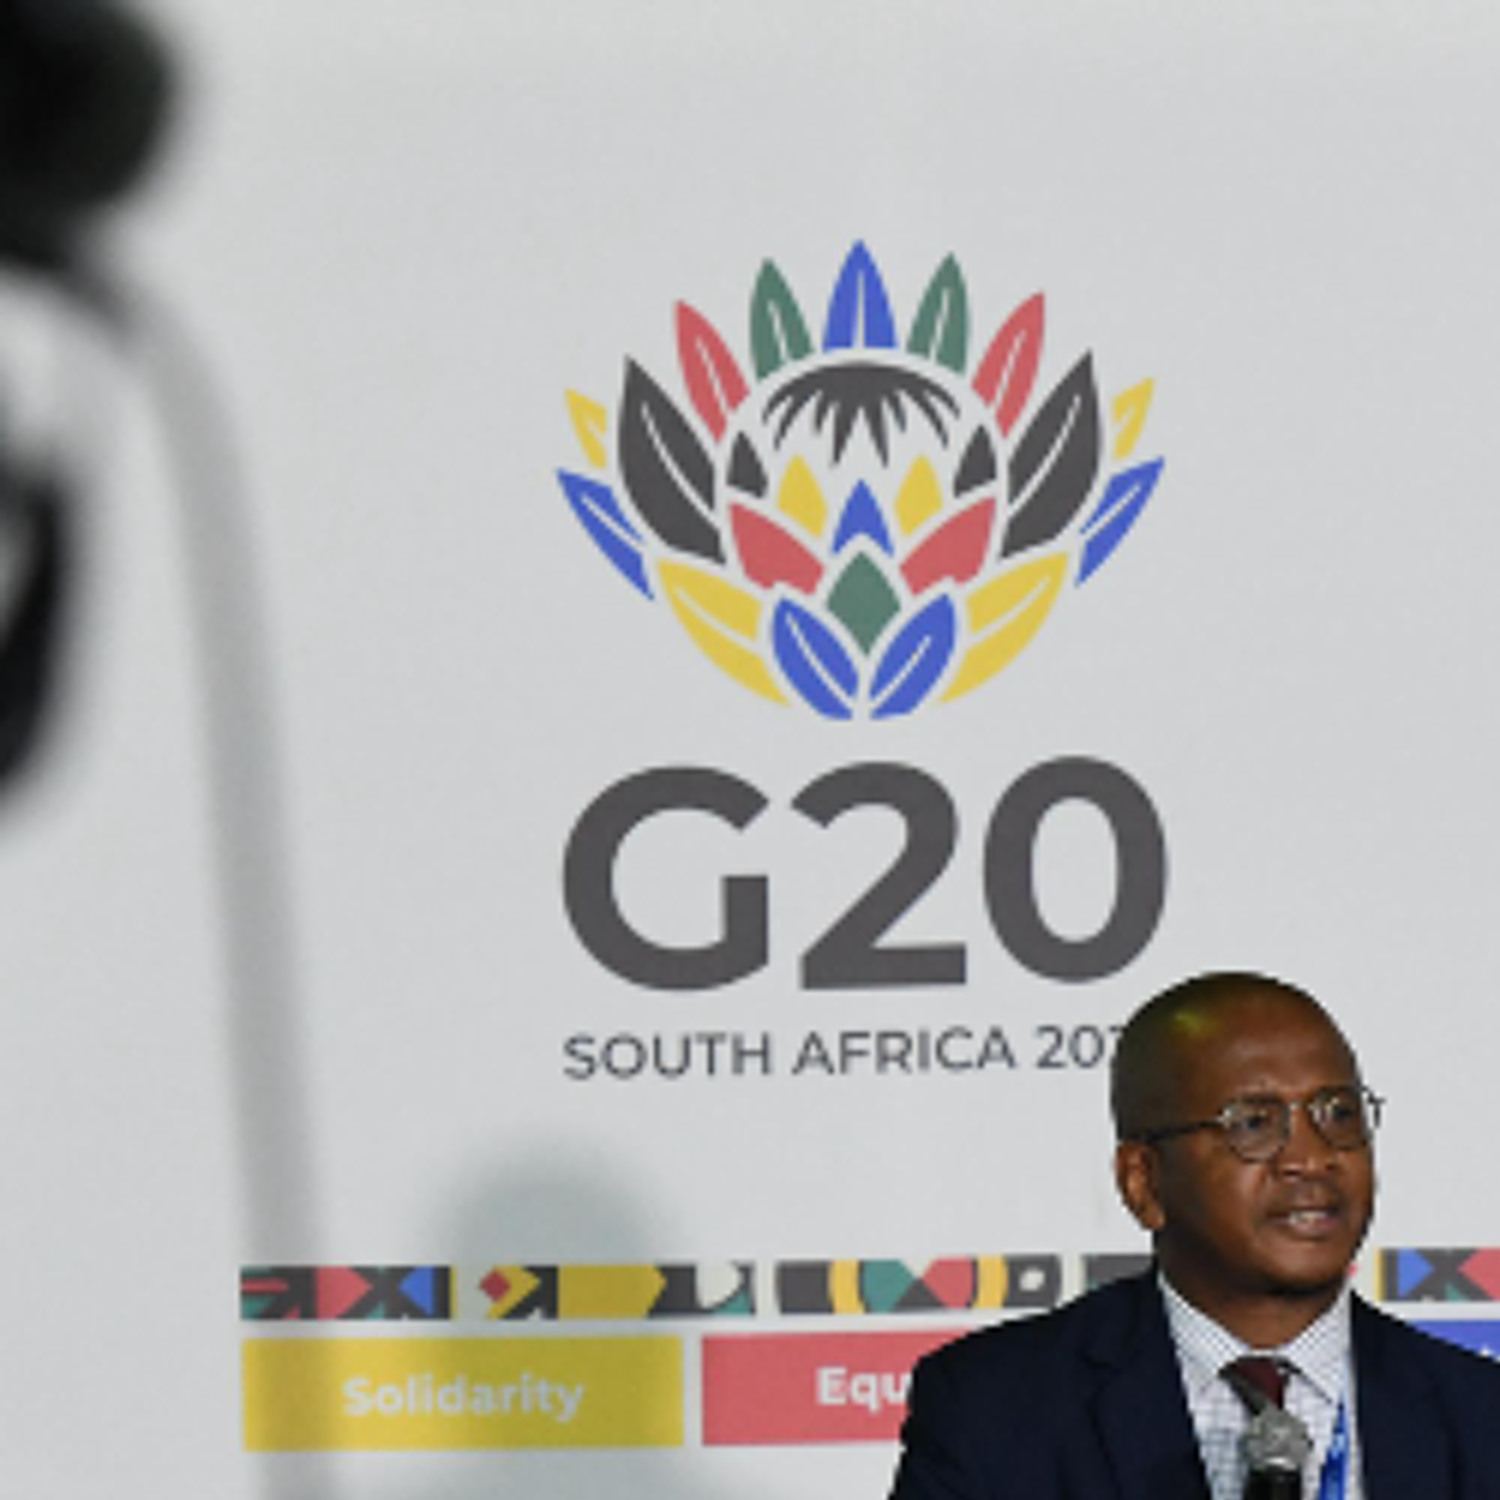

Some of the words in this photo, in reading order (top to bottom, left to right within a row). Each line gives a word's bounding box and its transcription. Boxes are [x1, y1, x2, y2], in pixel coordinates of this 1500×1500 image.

[562, 755, 1167, 990] G20
[563, 1032, 772, 1080] SOUTH
[791, 1026, 1017, 1076] AFRICA
[1034, 1024, 1120, 1070] 20
[341, 1371, 584, 1423] Solidarity
[815, 1366, 914, 1415] Equ
